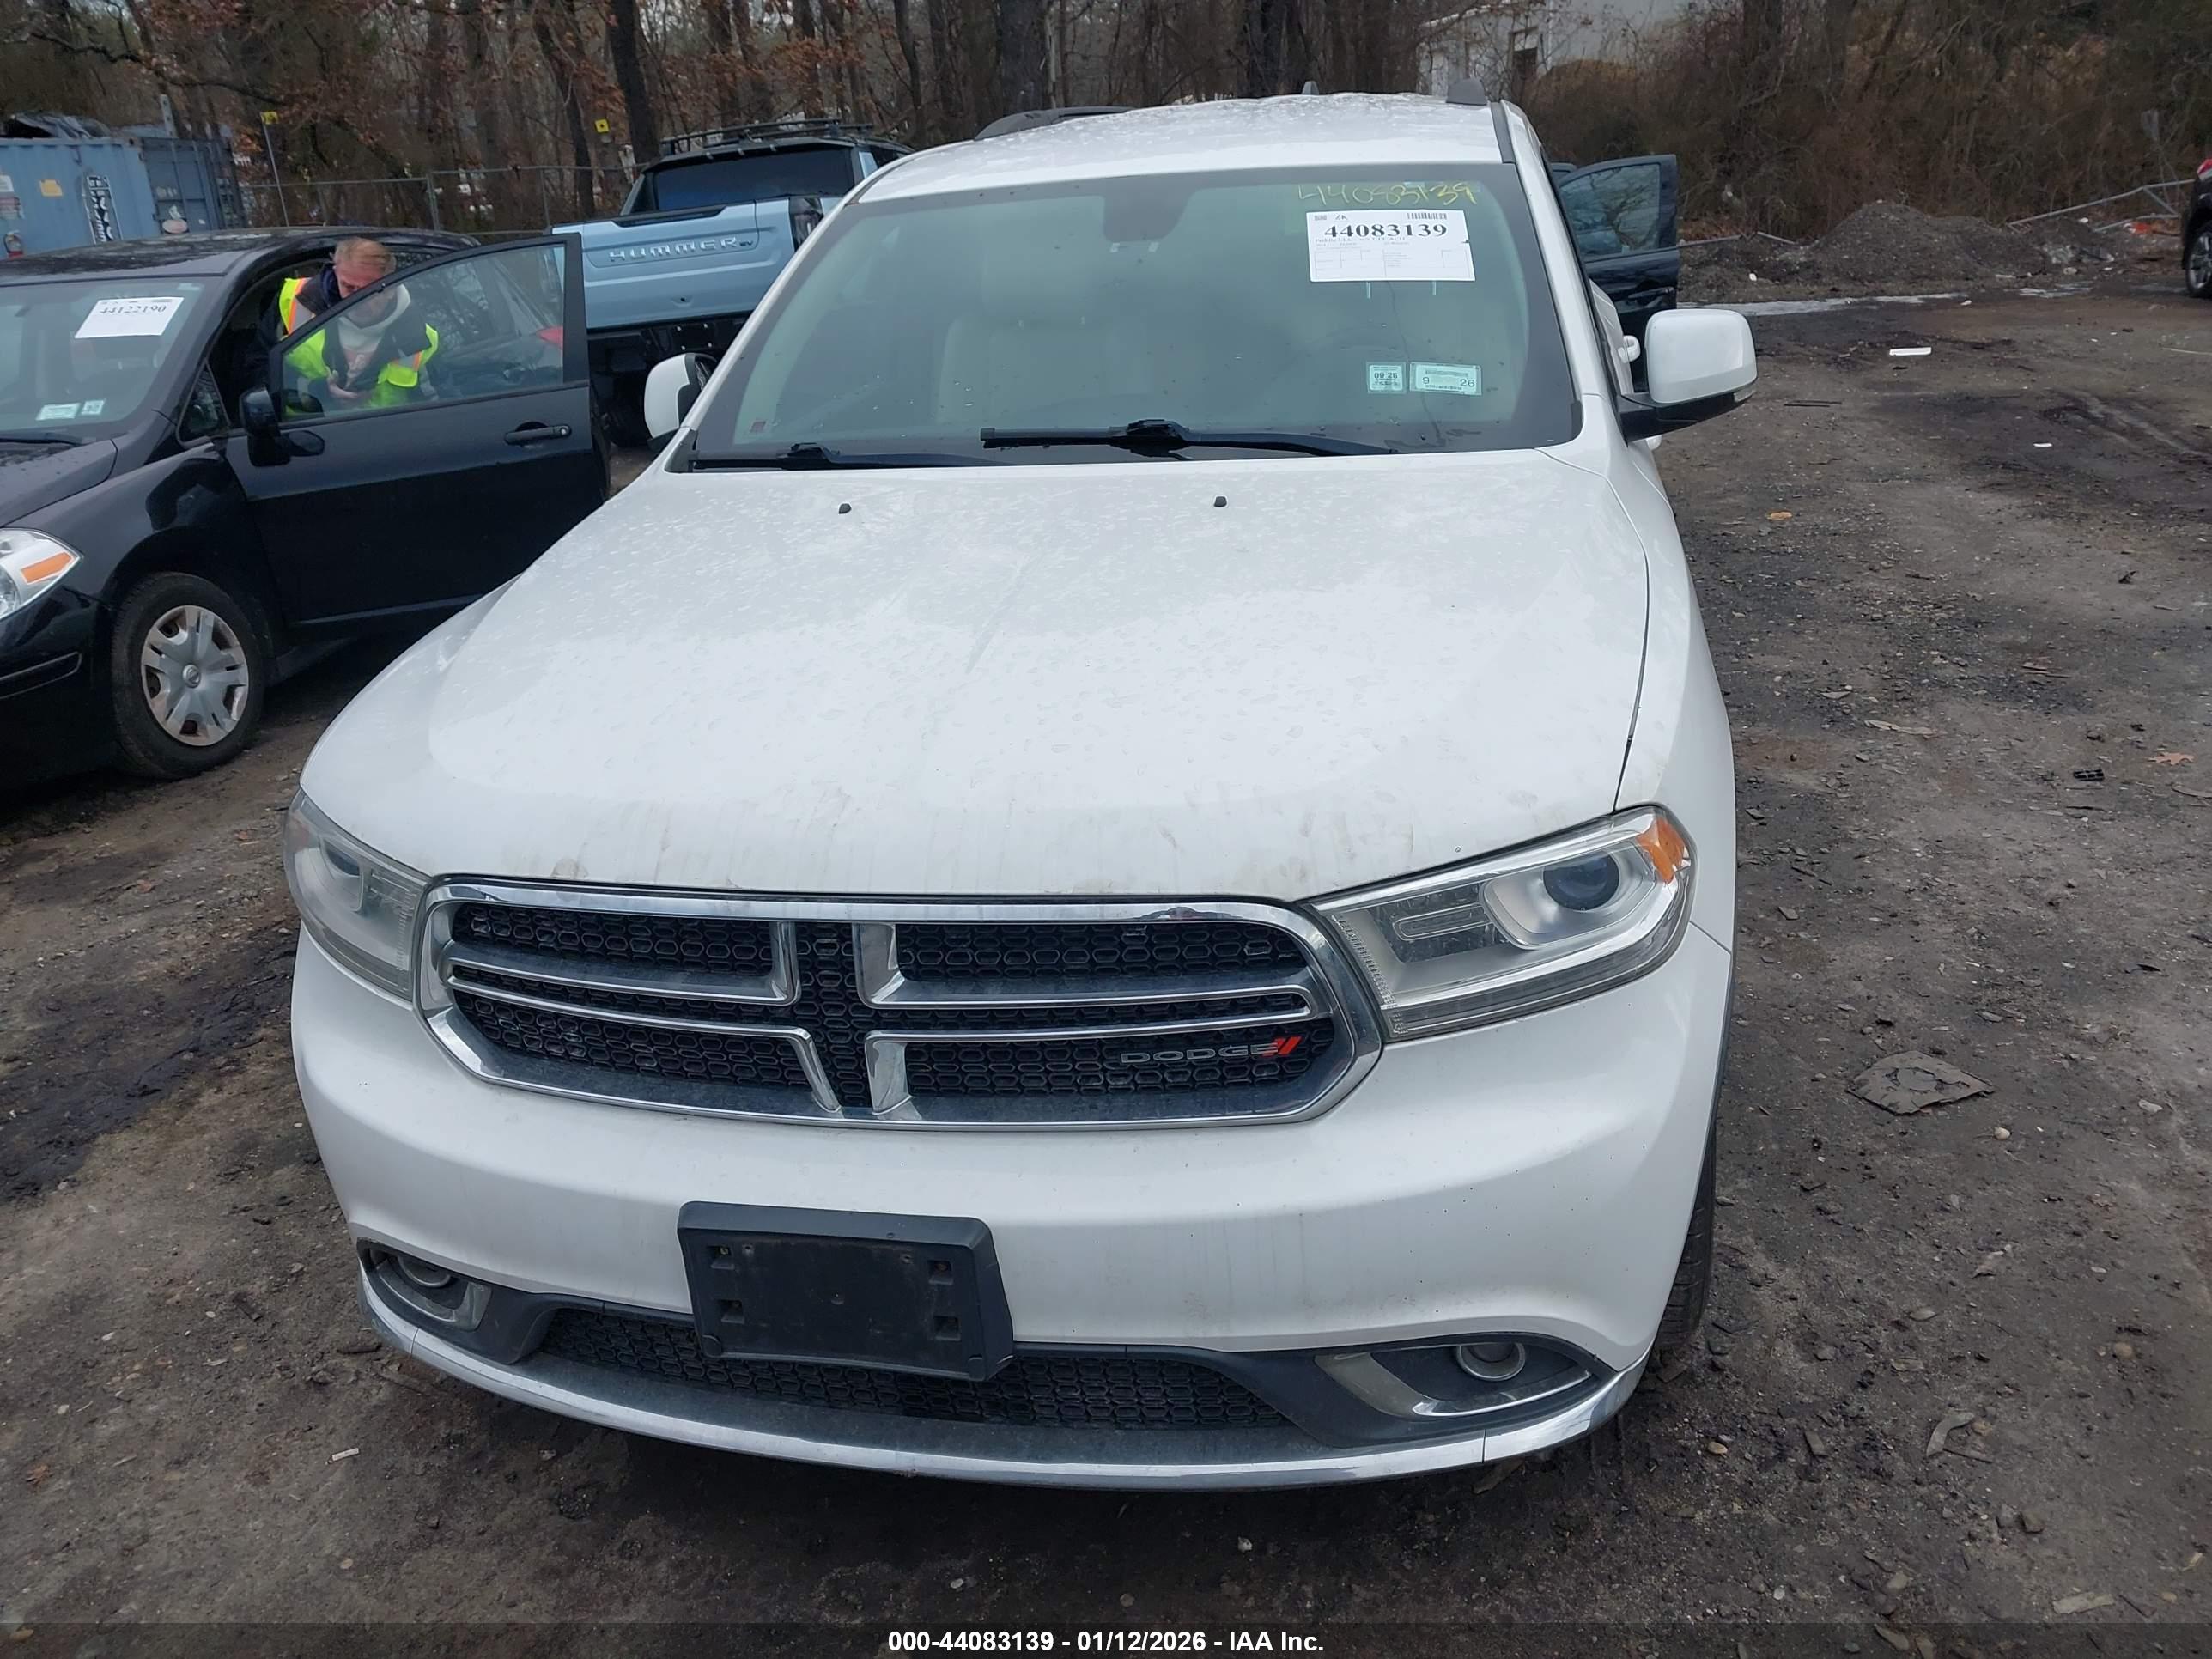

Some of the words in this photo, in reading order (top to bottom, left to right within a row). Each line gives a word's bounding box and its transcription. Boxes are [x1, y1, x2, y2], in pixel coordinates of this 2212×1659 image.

[1323, 223, 1448, 238] 44083139
[609, 236, 737, 262] HUMMER
[1422, 376, 1430, 385] 9
[1459, 379, 1475, 388] 26
[1121, 1042, 1279, 1064] DODGE
